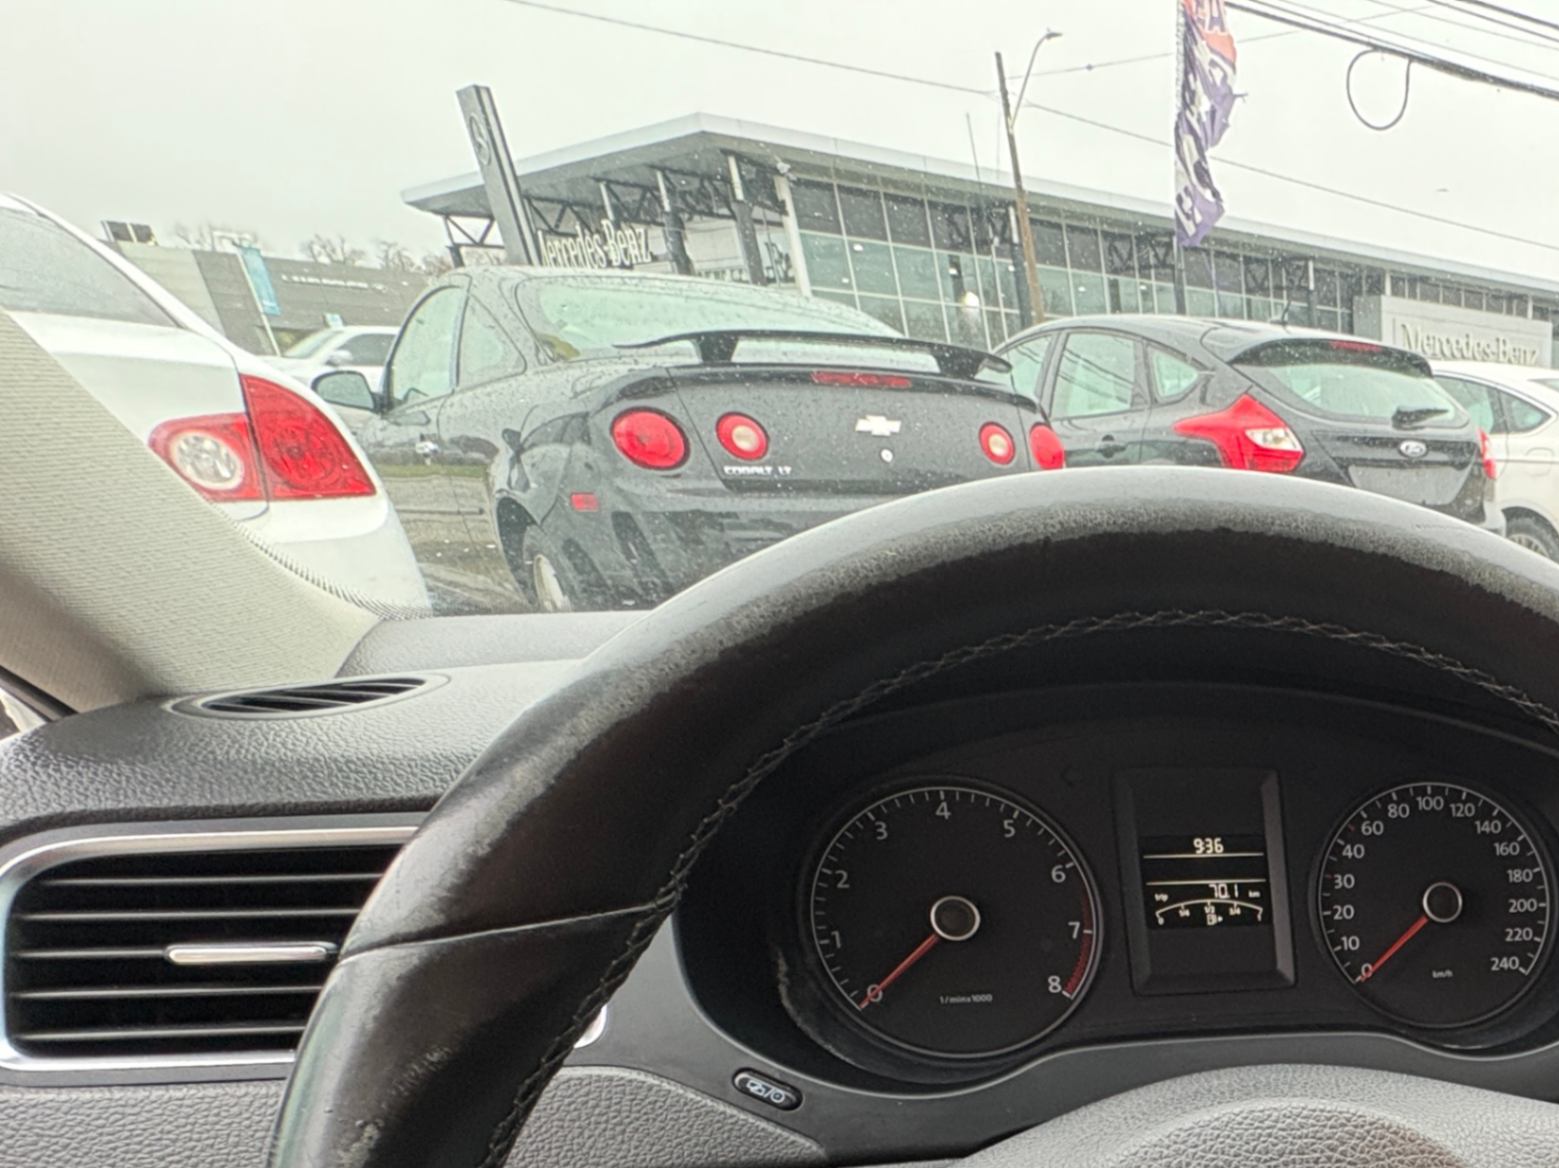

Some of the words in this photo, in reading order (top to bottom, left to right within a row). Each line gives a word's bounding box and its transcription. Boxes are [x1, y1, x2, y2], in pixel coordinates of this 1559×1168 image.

[1401, 323, 1538, 366] Mercedes-Benz
[935, 802, 951, 820] 4
[1387, 803, 1410, 818] 80
[1417, 796, 1444, 811] 100
[1451, 802, 1476, 817] 120
[877, 822, 888, 840] 3
[1004, 821, 1016, 838] 5
[1361, 820, 1384, 835] 60
[1475, 820, 1501, 834] 140
[1342, 844, 1365, 859] 40
[1495, 842, 1519, 856] 160
[835, 870, 850, 888] 2
[1051, 866, 1066, 883] 6
[1334, 873, 1354, 889] 30
[1508, 869, 1532, 882] 180
[1333, 905, 1354, 920] 20
[1508, 898, 1537, 912] 200
[1068, 921, 1080, 939] 7
[1505, 928, 1532, 942] 220
[831, 931, 842, 948] 1
[1341, 936, 1360, 950] 10
[1491, 957, 1519, 971] 240
[1047, 975, 1062, 993] 8
